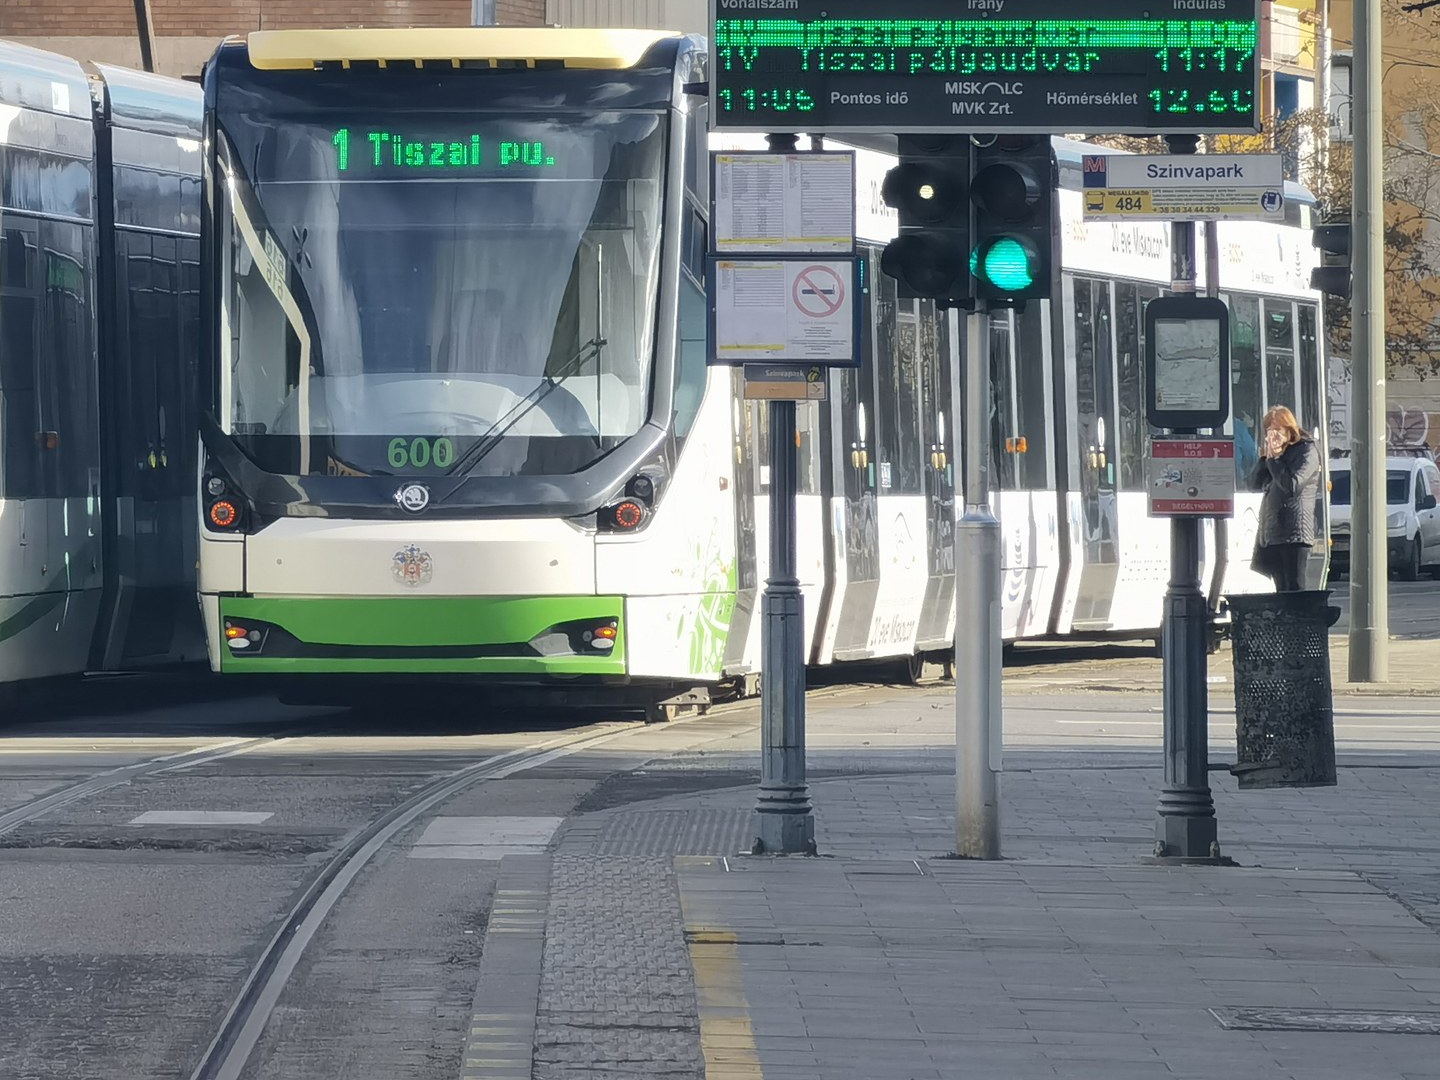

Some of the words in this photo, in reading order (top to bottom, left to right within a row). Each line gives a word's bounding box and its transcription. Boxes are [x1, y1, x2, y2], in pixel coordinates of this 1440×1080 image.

[797, 47, 896, 70] Tiszai
[910, 47, 1101, 74] pályaudvar
[1155, 47, 1253, 71] 11:17
[830, 92, 882, 105] Pontos
[885, 91, 909, 105] idő
[1046, 91, 1138, 105] Hőmérséklet
[952, 103, 986, 115] MVK
[988, 102, 1014, 115] Zrt.
[332, 128, 349, 170] 1
[368, 133, 481, 166] Tiszai
[500, 141, 555, 166] pu.
[1146, 163, 1244, 181] Szinvapark
[1115, 197, 1143, 211] 484
[387, 437, 454, 468] 600
